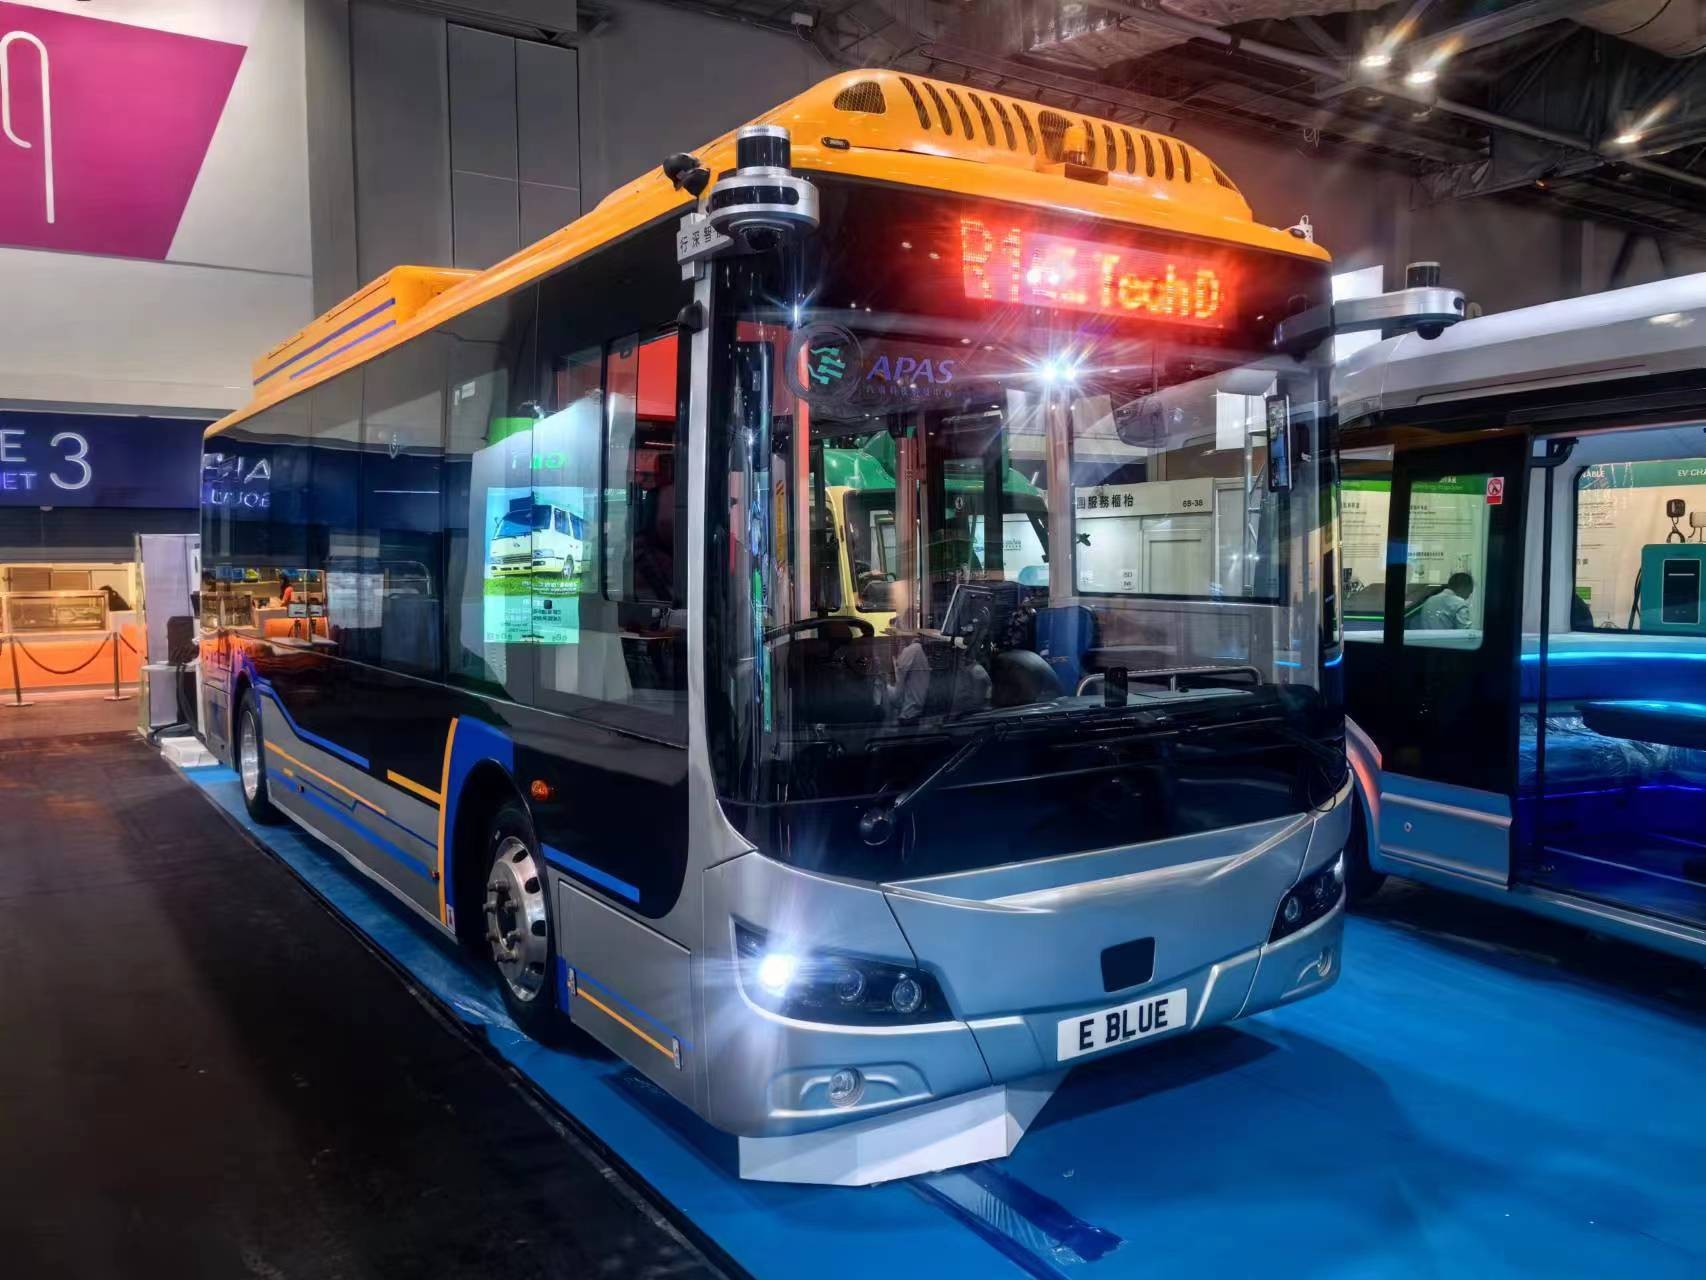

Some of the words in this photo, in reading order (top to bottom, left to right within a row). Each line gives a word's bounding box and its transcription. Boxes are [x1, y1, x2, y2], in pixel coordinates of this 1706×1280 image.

[866, 355, 955, 384] APAS
[50, 432, 92, 490] 3
[1079, 1018, 1095, 1051] E
[1105, 998, 1169, 1043] BLUE
